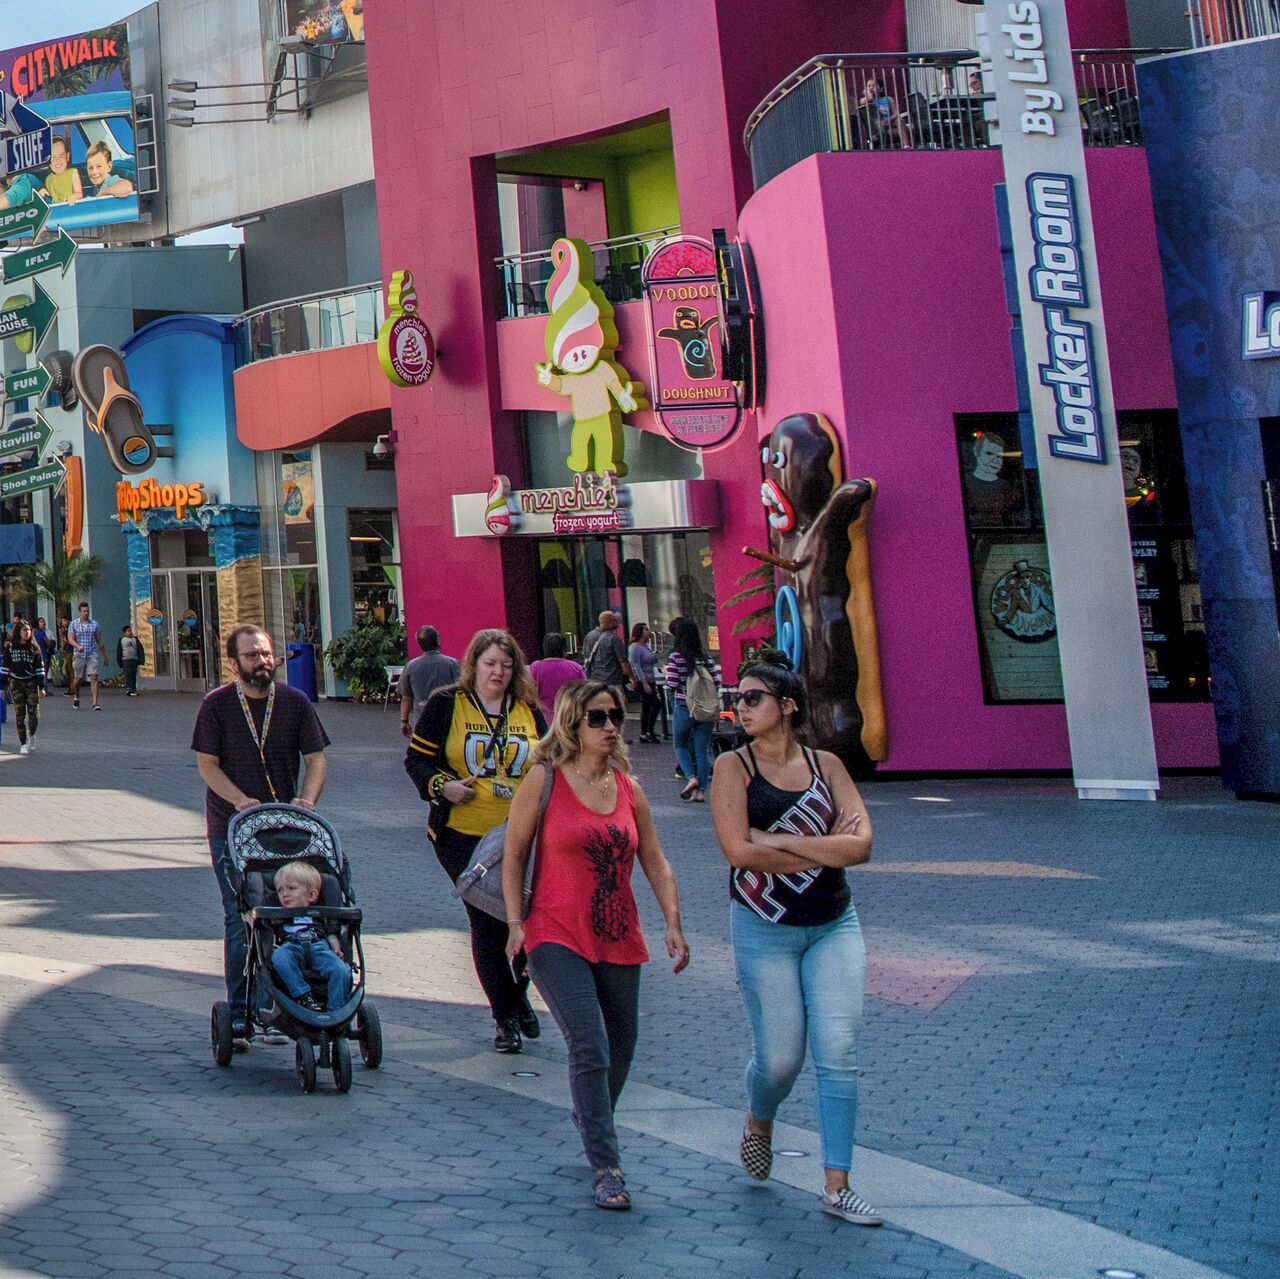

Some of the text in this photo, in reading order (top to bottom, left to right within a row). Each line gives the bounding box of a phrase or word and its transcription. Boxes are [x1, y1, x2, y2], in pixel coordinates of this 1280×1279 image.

[12, 37, 117, 97] CITYWALK
[1002, 0, 1064, 136] By Lids
[13, 131, 43, 170] STUFF
[25, 252, 51, 267] IFLY
[394, 318, 427, 337] menchie's
[1029, 173, 1104, 461] Locker Room
[392, 357, 433, 384] frozen yogurt
[13, 377, 38, 390] FUN
[663, 386, 730, 400] DOUGHNUT
[2, 469, 64, 492] Shoe Palace
[521, 470, 618, 513] menchie's
[554, 512, 619, 532] frozen yogurt
[465, 722, 526, 733] HUFUFF
